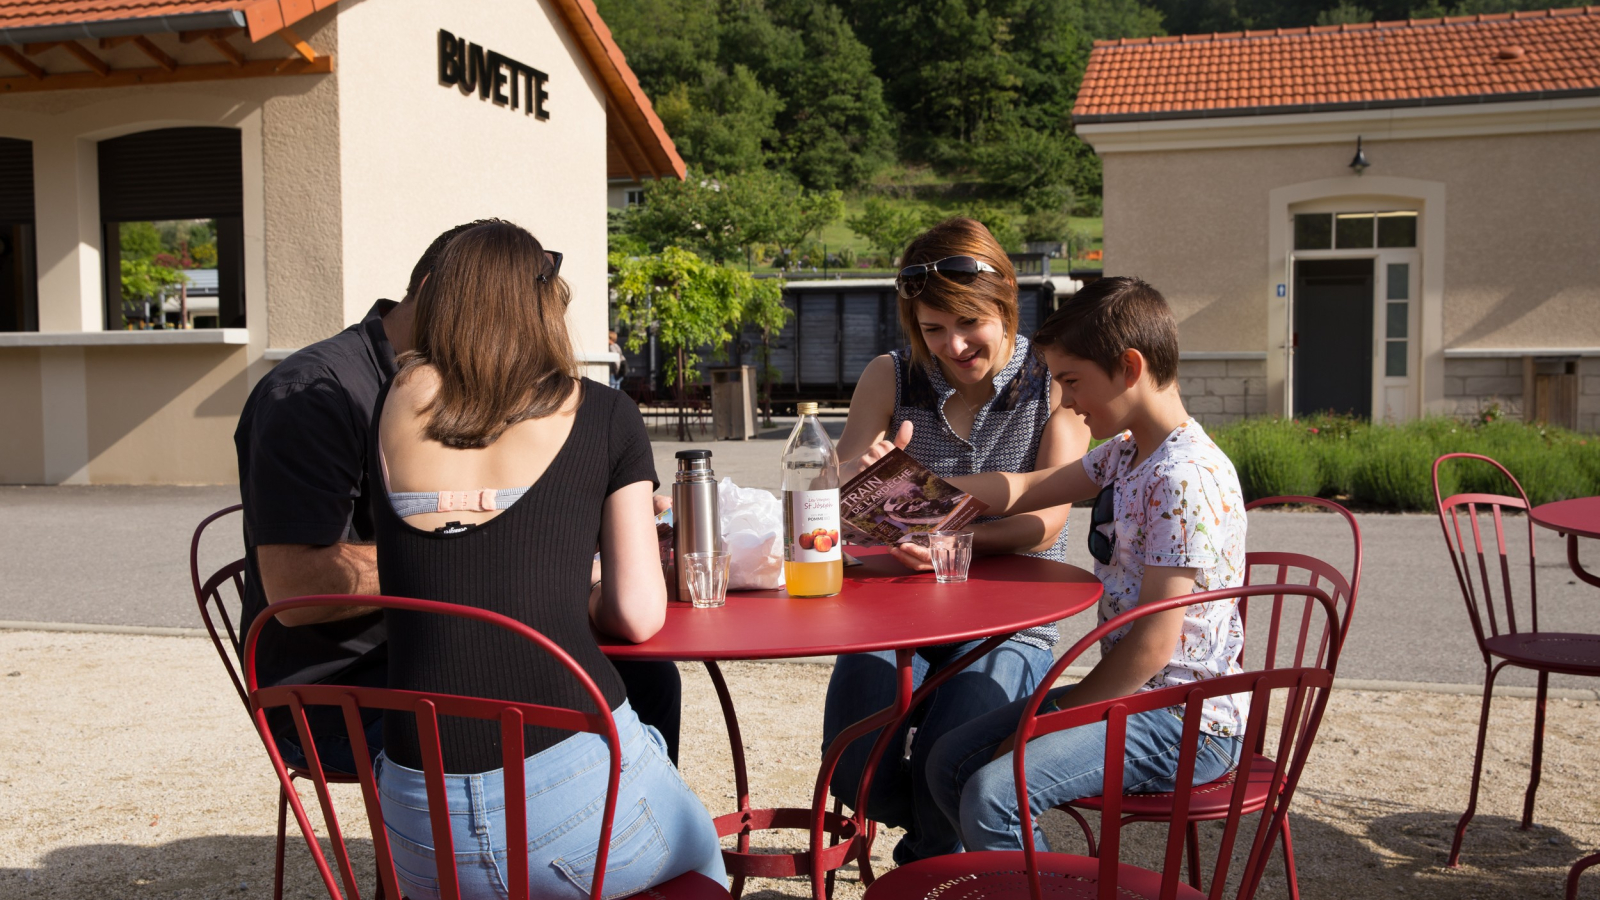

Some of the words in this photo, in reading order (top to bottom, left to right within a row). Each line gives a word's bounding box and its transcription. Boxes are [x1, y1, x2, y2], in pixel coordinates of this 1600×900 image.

[438, 28, 550, 121] BUVETTE
[841, 476, 883, 507] TRAIN
[804, 502, 812, 510] St
[851, 504, 864, 515] DE
